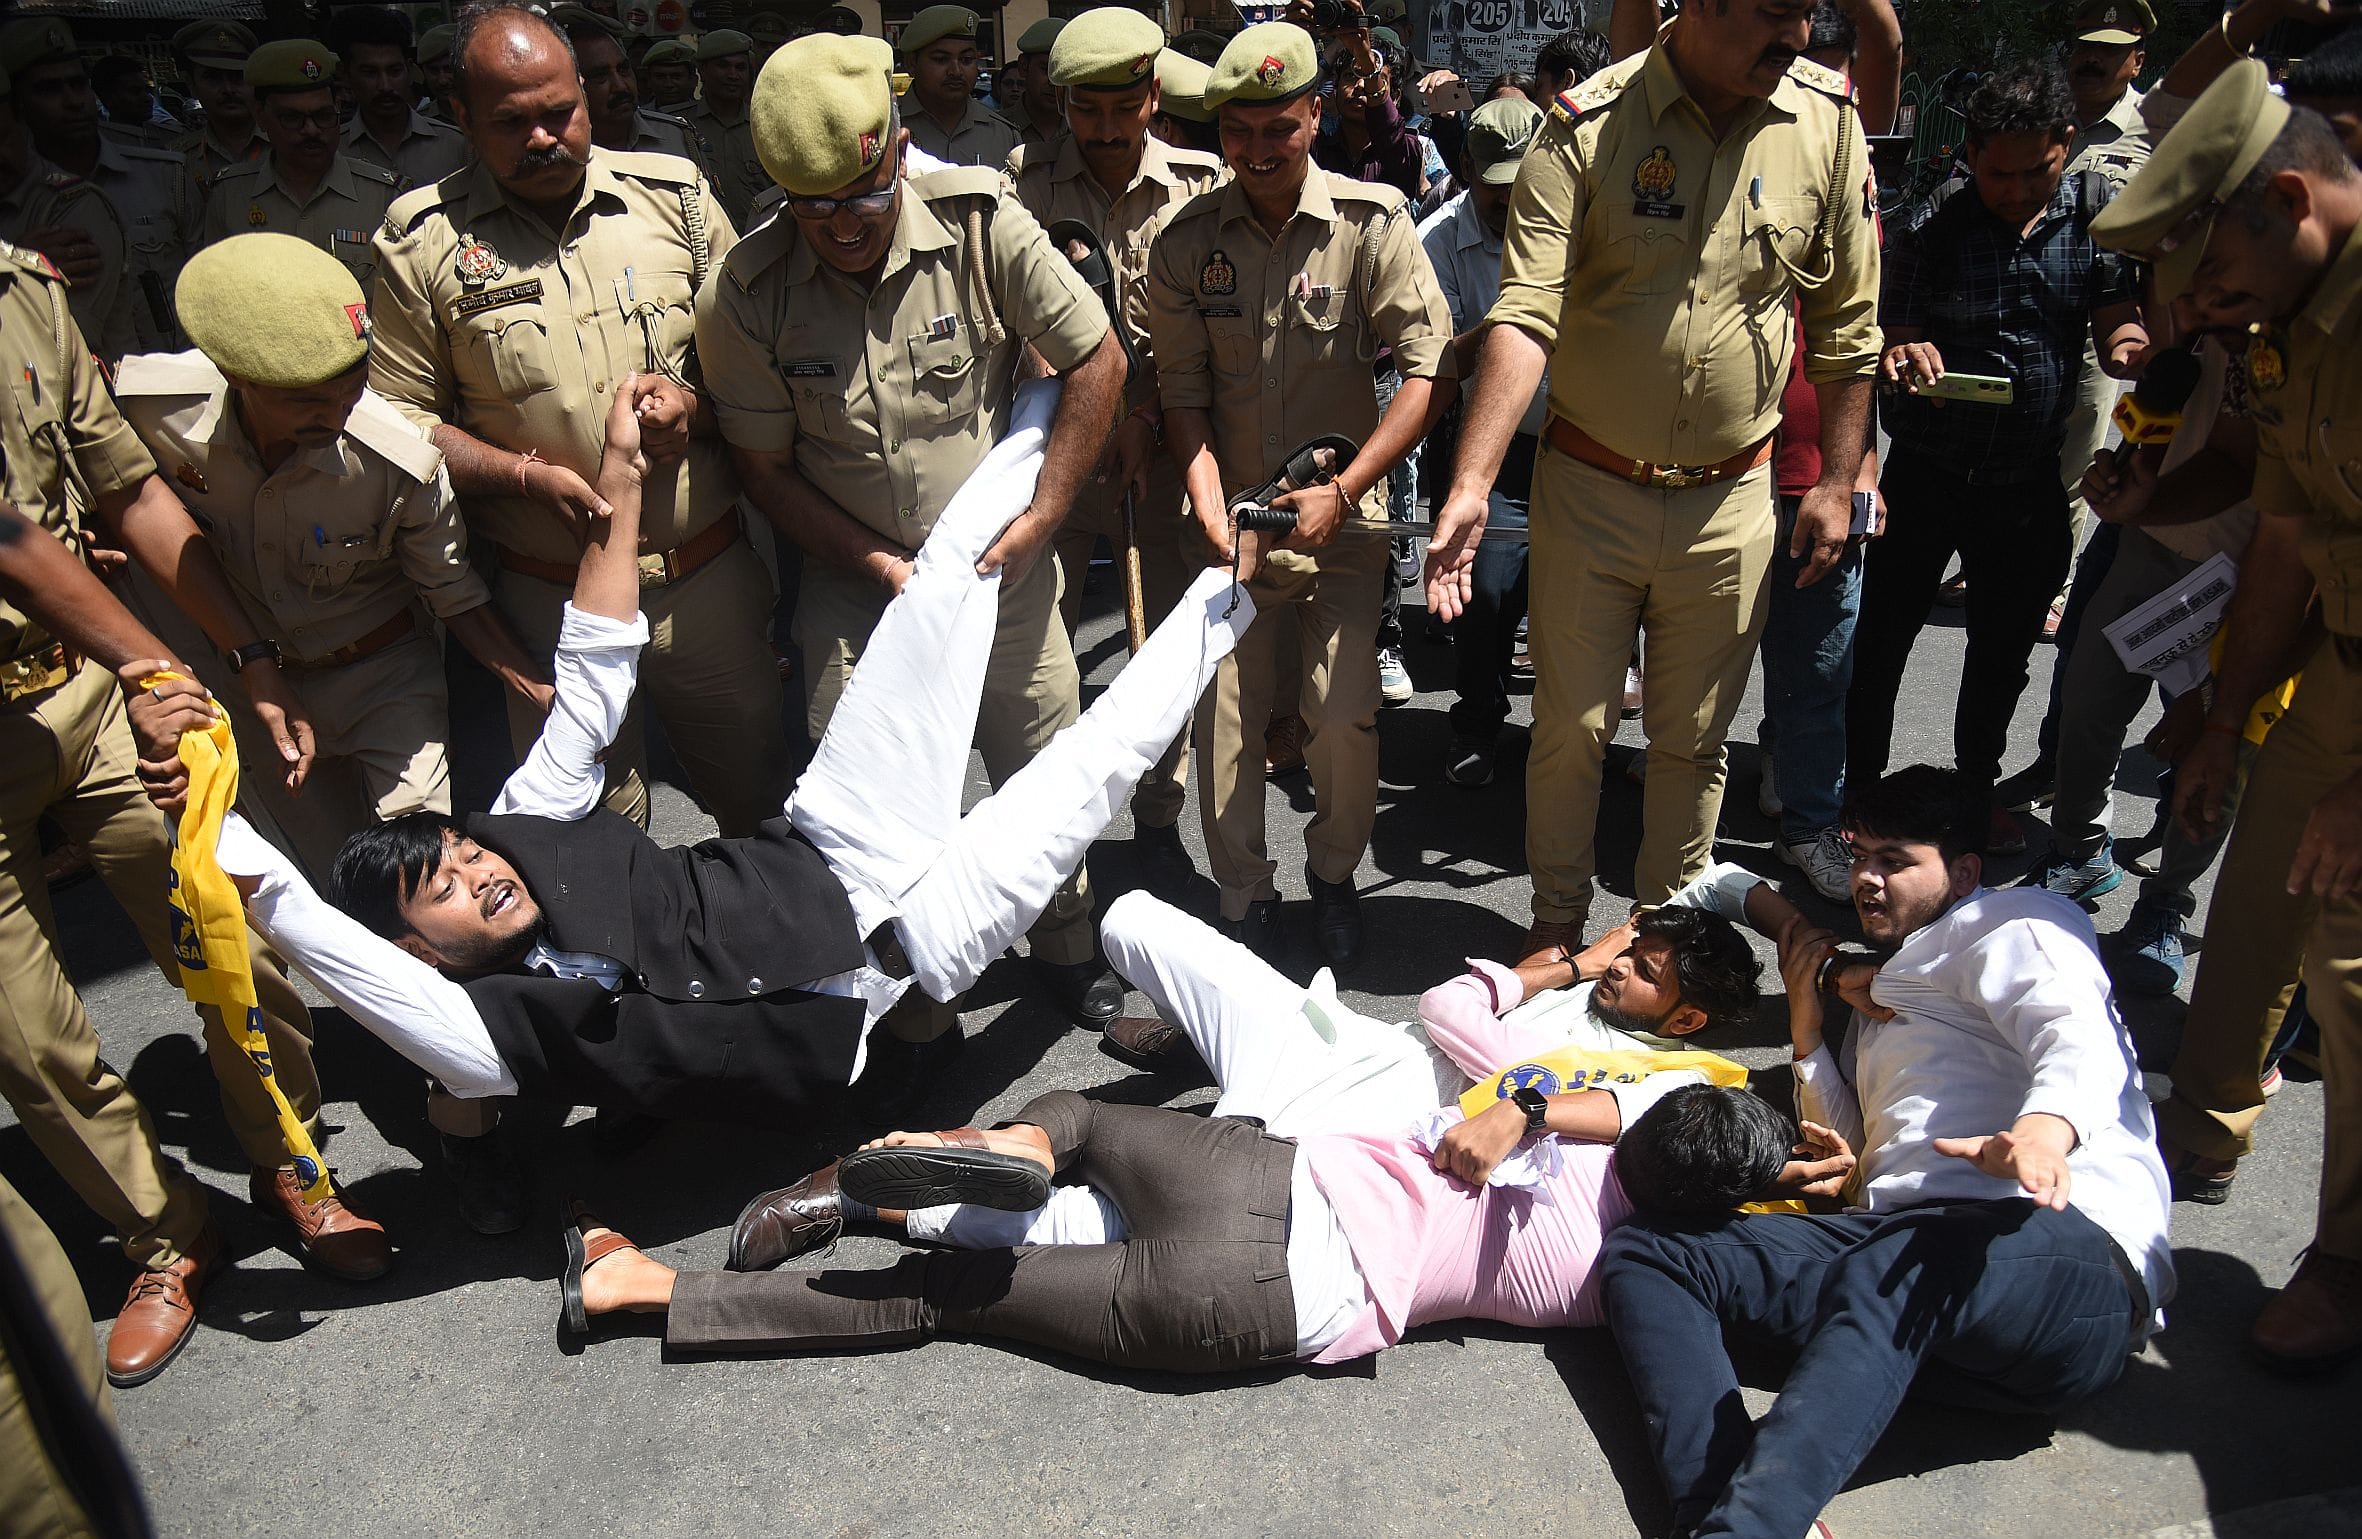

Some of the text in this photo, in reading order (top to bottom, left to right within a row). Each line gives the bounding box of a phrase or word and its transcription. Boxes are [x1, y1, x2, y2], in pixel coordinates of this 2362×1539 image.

[1470, 1, 1507, 26] 205
[1506, 30, 1529, 41] प्रदीप
[175, 944, 204, 961] ASA
